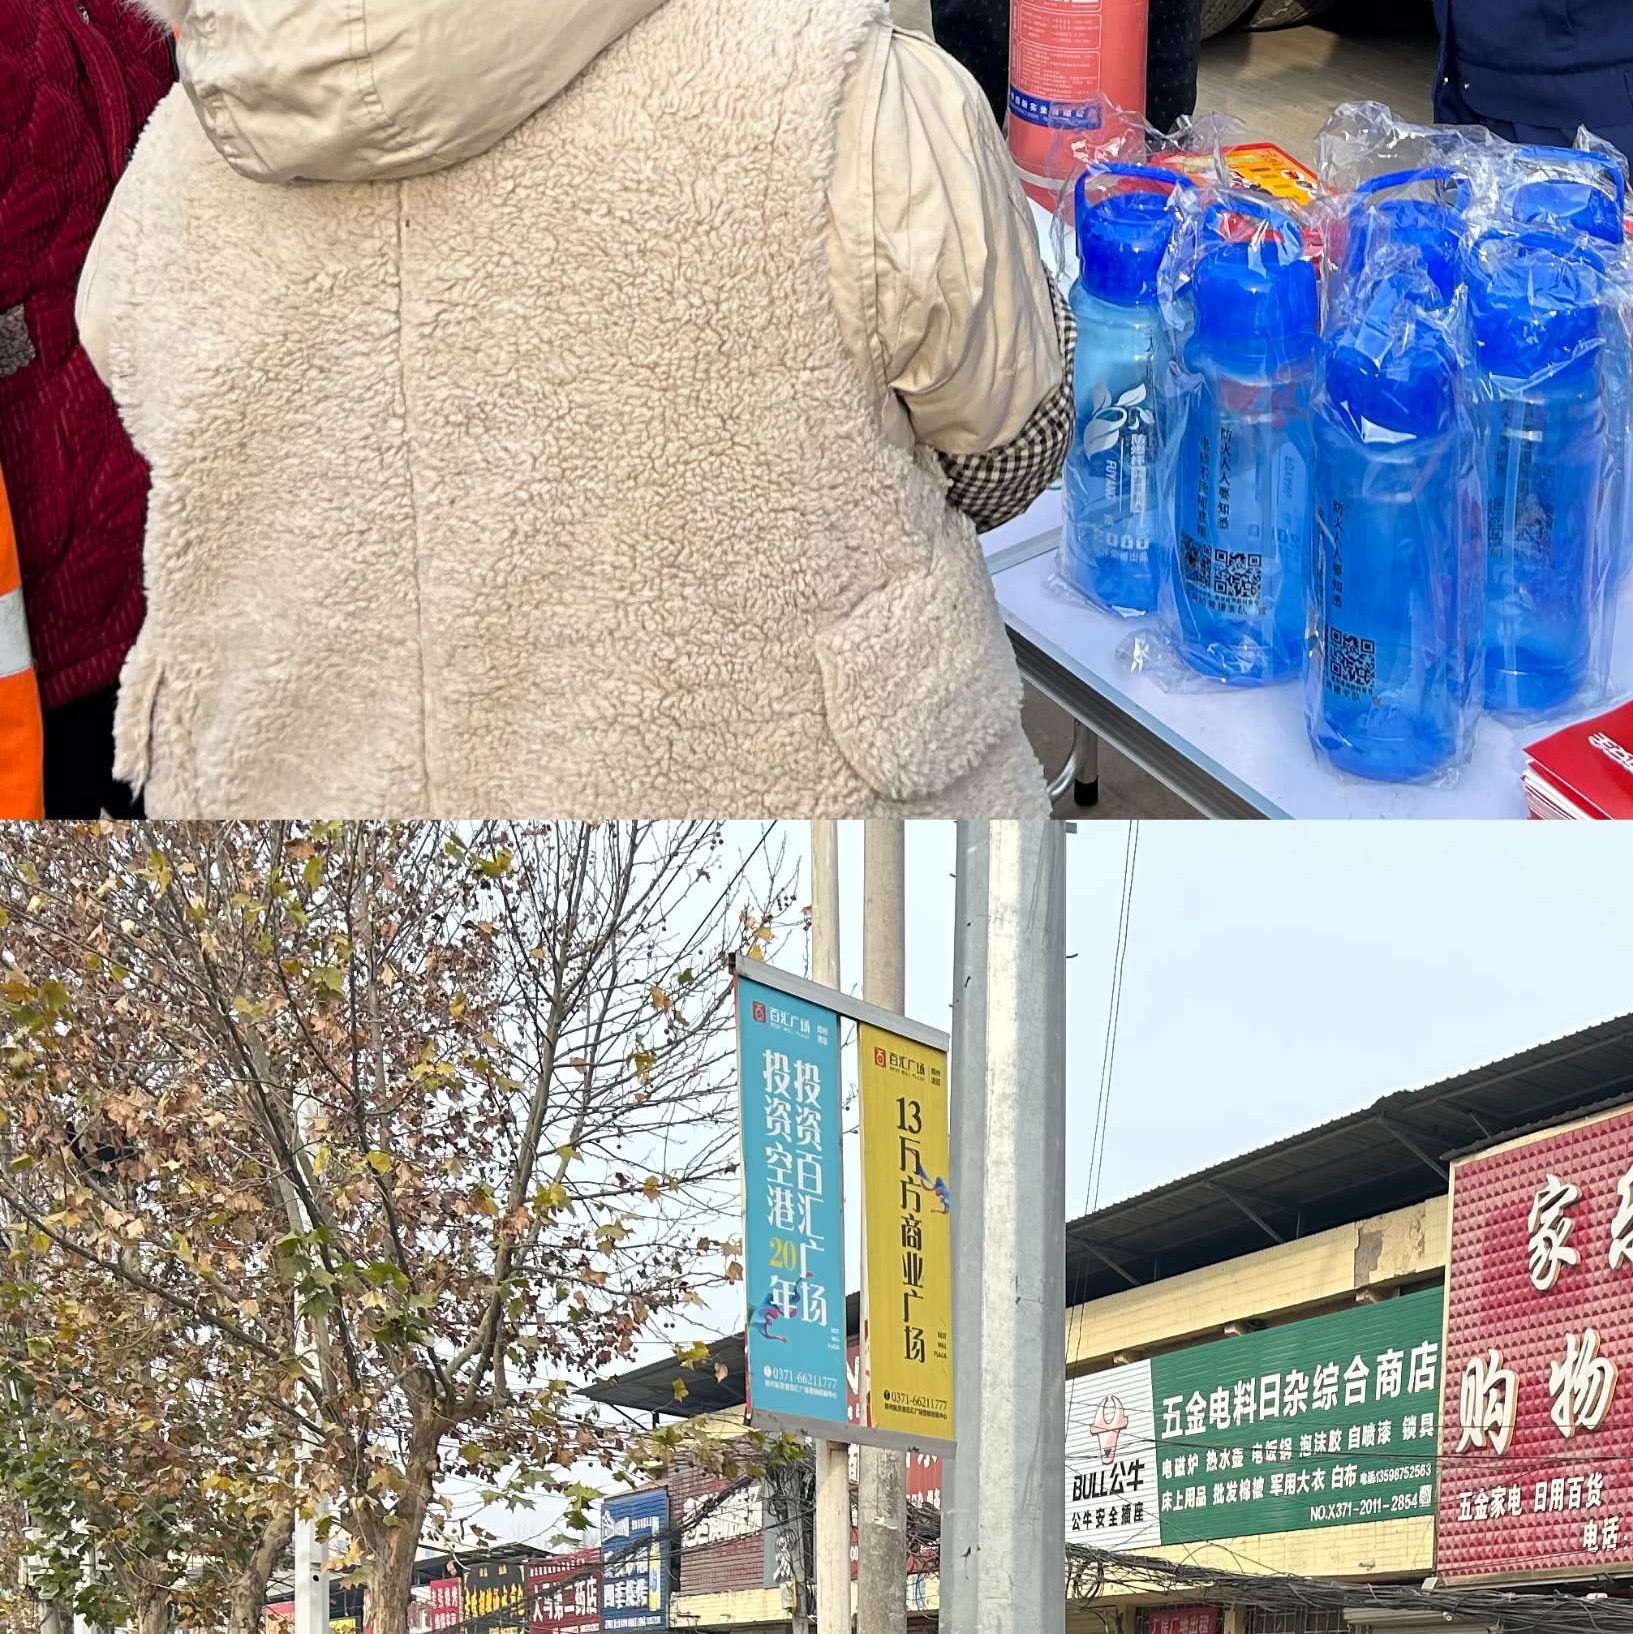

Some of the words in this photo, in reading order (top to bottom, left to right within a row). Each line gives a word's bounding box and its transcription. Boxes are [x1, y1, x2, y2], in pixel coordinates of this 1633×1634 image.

[1104, 459, 1118, 501] FUYANG
[769, 1007, 811, 1035] 百汇广场
[889, 1052, 926, 1076] 百汇广场
[761, 1048, 798, 1320] 投资空港20年
[793, 1058, 828, 1328] 投资百汇广场
[896, 1096, 926, 1365] 13万方商业广场
[772, 1368, 838, 1389] 0371-66211777
[891, 1391, 949, 1412] 0371-66211777
[1160, 1340, 1440, 1440] 五金电料日杂综合商店
[1161, 1453, 1199, 1479] 电磁炉
[1205, 1446, 1245, 1473] 热水壶
[1299, 1429, 1343, 1458] 泡沫胶
[1347, 1420, 1393, 1450] 自喷漆
[1401, 1412, 1435, 1442] 锁具
[1072, 1459, 1145, 1502] BULL公牛
[1161, 1485, 1207, 1513] 床上用品
[1212, 1476, 1265, 1506] 批发棉被
[1269, 1468, 1326, 1498] 军用大衣
[1330, 1463, 1358, 1489] 白布
[1457, 1487, 1522, 1523] 五金家电
[1533, 1471, 1604, 1513] 日用百货
[1071, 1501, 1145, 1533] 公牛安全插座
